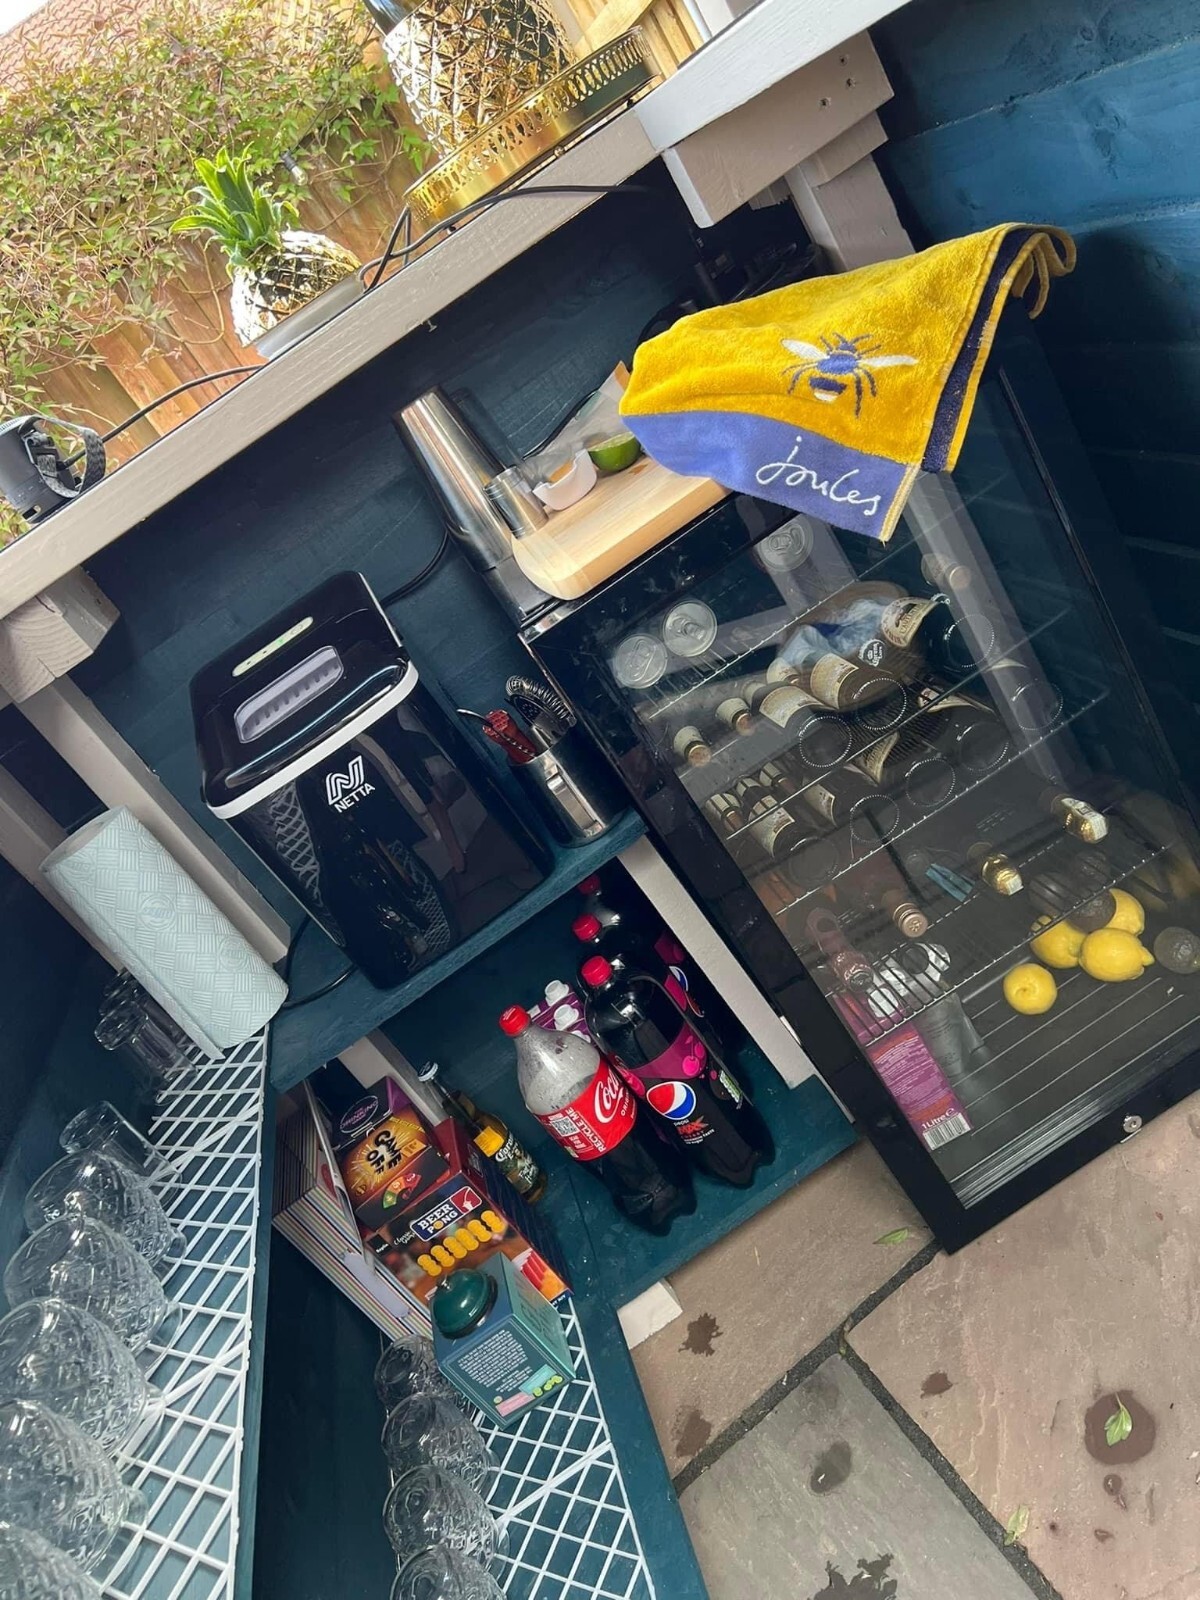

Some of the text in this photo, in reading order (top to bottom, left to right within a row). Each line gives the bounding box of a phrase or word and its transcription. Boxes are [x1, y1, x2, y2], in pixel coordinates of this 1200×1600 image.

[756, 435, 881, 516] joules
[334, 783, 375, 813] NETTA
[565, 1106, 580, 1120] ME
[375, 1130, 402, 1170] GAME
[495, 1132, 514, 1162] Coron
[576, 1119, 607, 1153] RECYCLE
[366, 1149, 386, 1175] OFF
[417, 1203, 454, 1230] BEER
[426, 1210, 459, 1234] PONG
